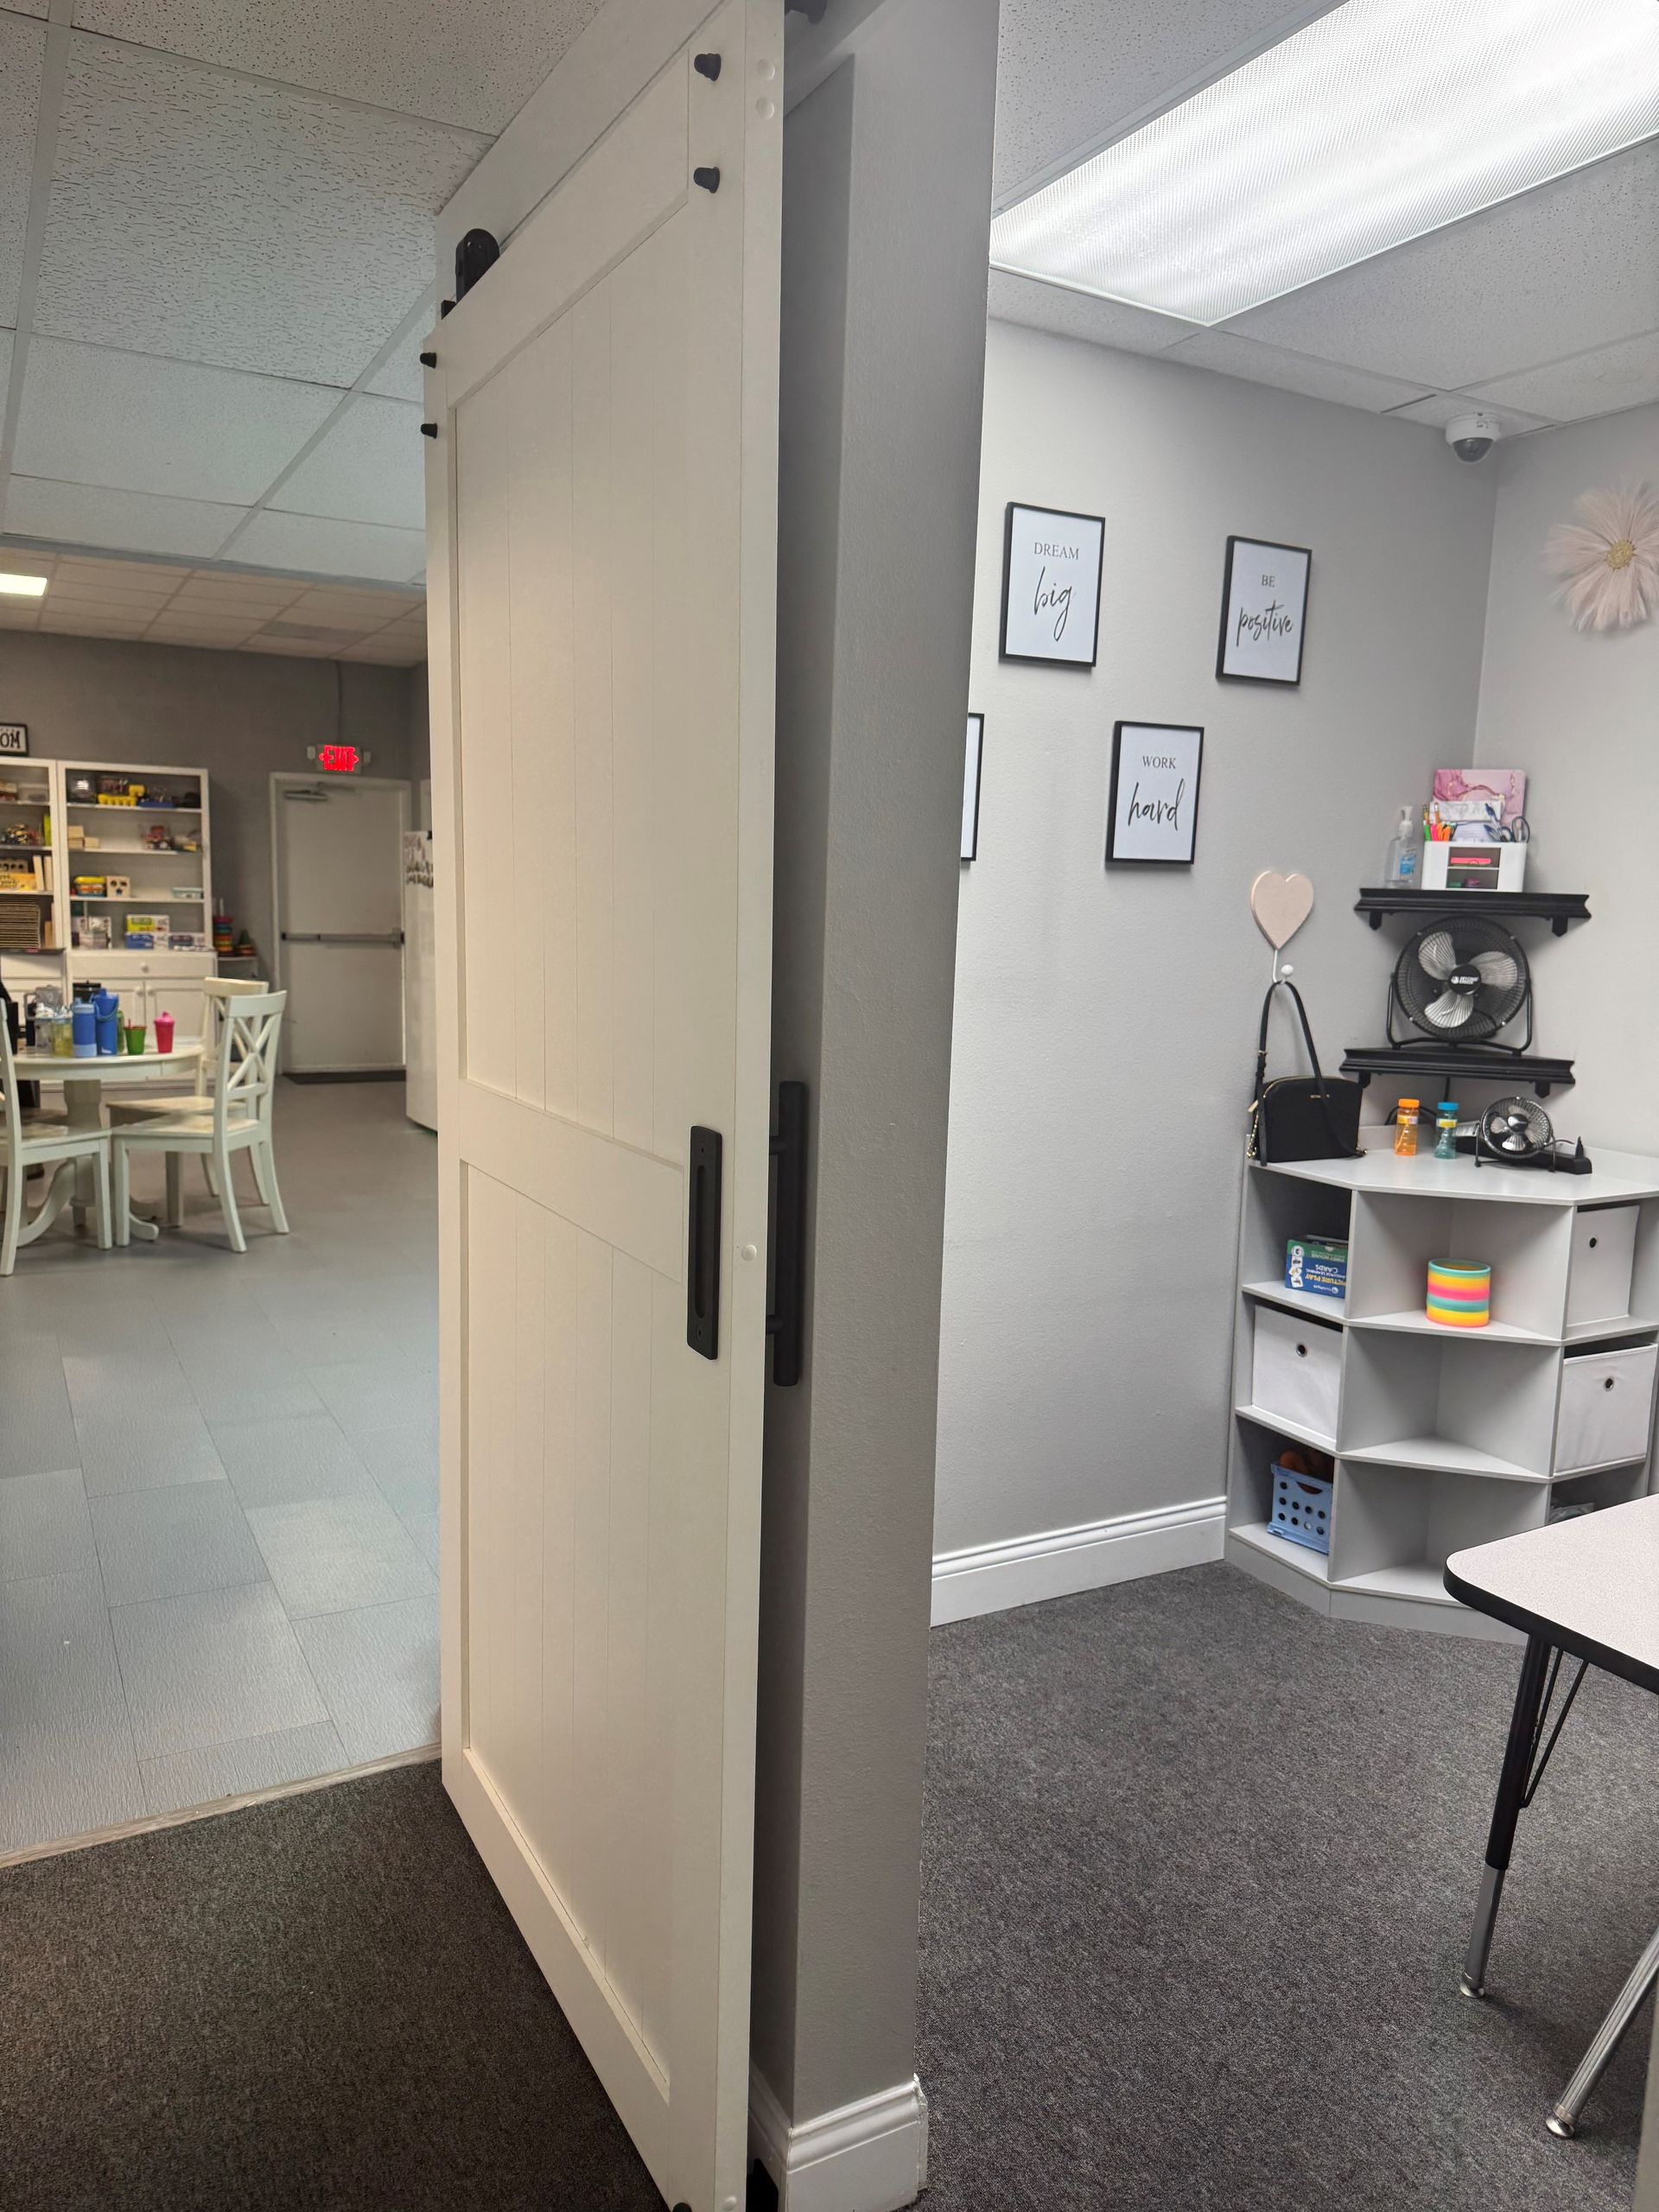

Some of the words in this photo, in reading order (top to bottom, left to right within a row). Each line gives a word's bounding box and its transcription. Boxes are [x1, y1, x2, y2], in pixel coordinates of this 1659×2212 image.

[1034, 542, 1079, 560] DREAM
[1262, 575, 1275, 588] BE
[1033, 566, 1072, 642] big
[1236, 599, 1294, 647] positive
[324, 745, 356, 772] EXIT
[1142, 755, 1177, 769] WORK
[1128, 778, 1185, 831] hard
[1314, 1264, 1338, 1274] CARDS
